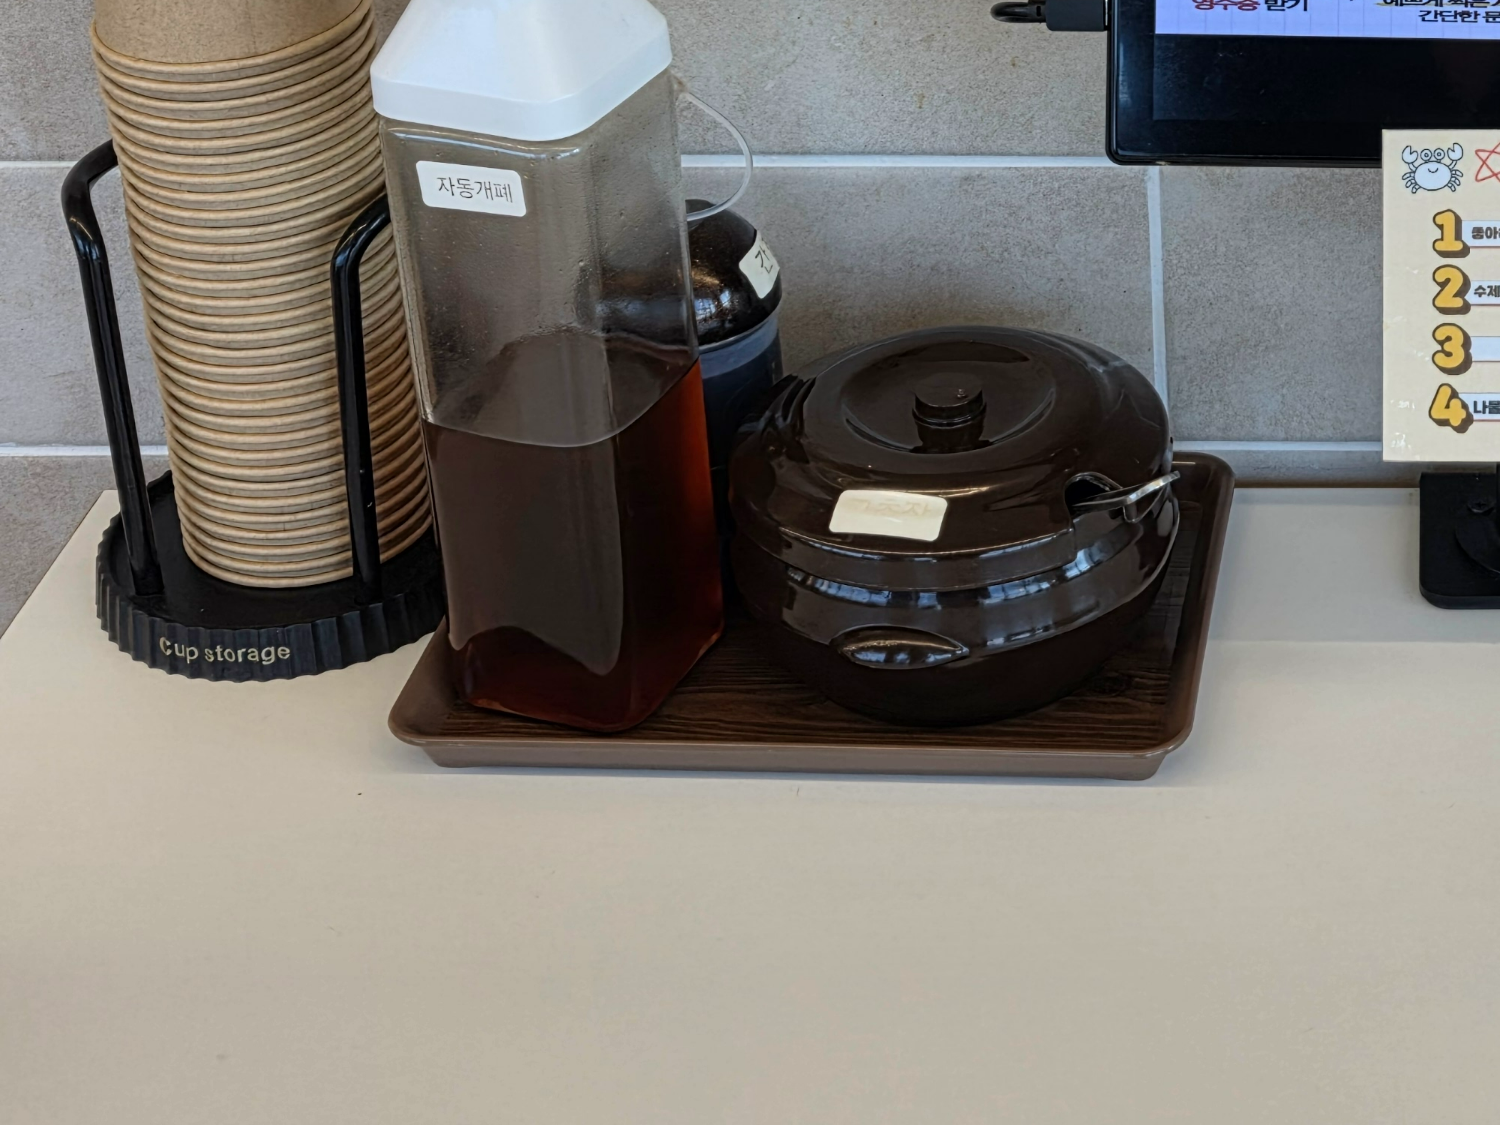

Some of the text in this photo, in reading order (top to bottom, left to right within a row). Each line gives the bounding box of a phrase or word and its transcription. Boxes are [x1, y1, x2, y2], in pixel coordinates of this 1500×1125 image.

[1419, 10, 1479, 23] 간단한
[437, 177, 513, 203] 자동개폐
[1432, 209, 1470, 258] 1
[1432, 264, 1471, 315] 2
[1474, 285, 1500, 297] 수제
[1432, 322, 1472, 375] 3
[1429, 383, 1473, 433] 4
[159, 636, 291, 665] Cup storage
